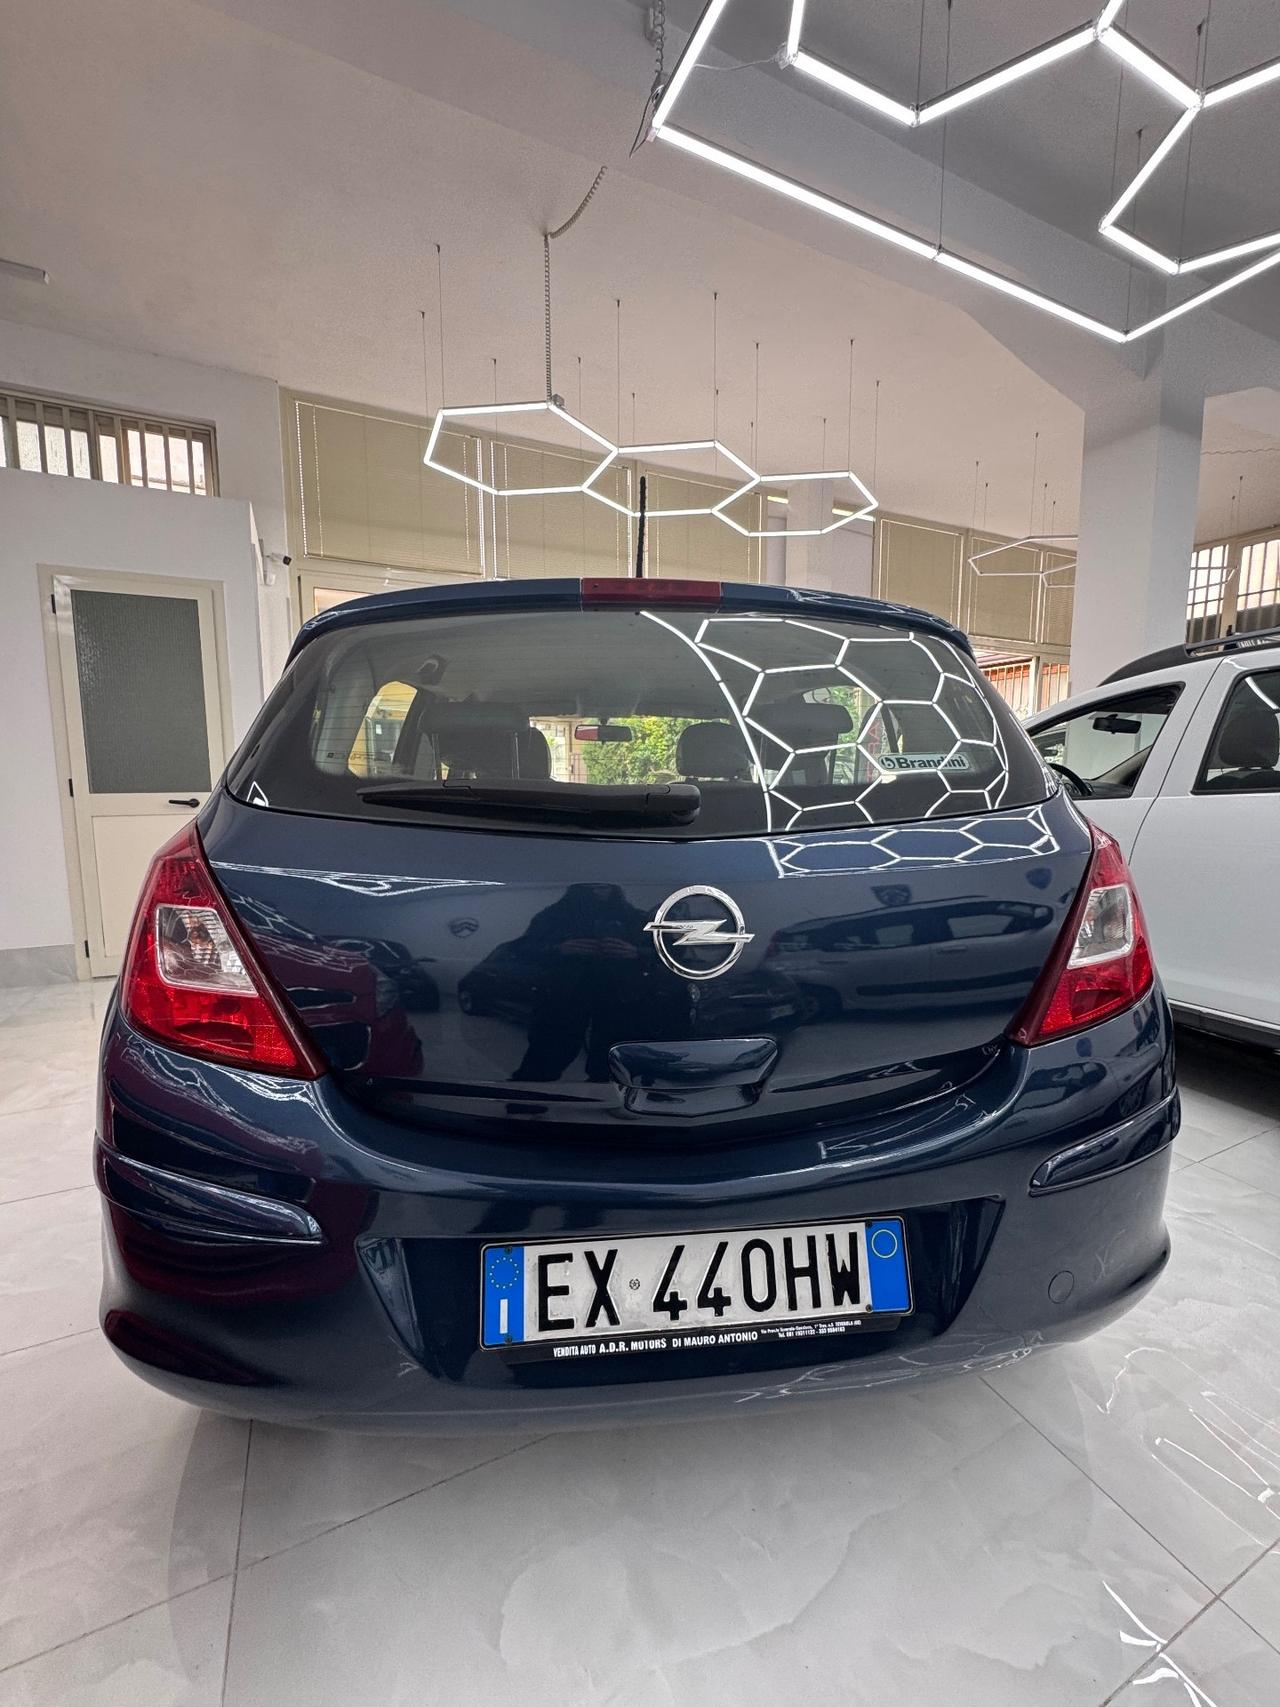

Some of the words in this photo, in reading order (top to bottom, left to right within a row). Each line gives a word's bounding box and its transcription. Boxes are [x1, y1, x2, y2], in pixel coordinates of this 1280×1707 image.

[895, 755, 967, 769] Brandini
[537, 1248, 620, 1332] EX
[652, 1231, 861, 1321] 440HW
[553, 1345, 579, 1358] VENDITA
[580, 1344, 596, 1355] AUTO
[599, 1341, 629, 1354] A.D.R.
[631, 1338, 667, 1351] MOTORS
[672, 1337, 682, 1348] DI
[684, 1334, 716, 1347] MAURO
[718, 1331, 758, 1344] ANTONIO
